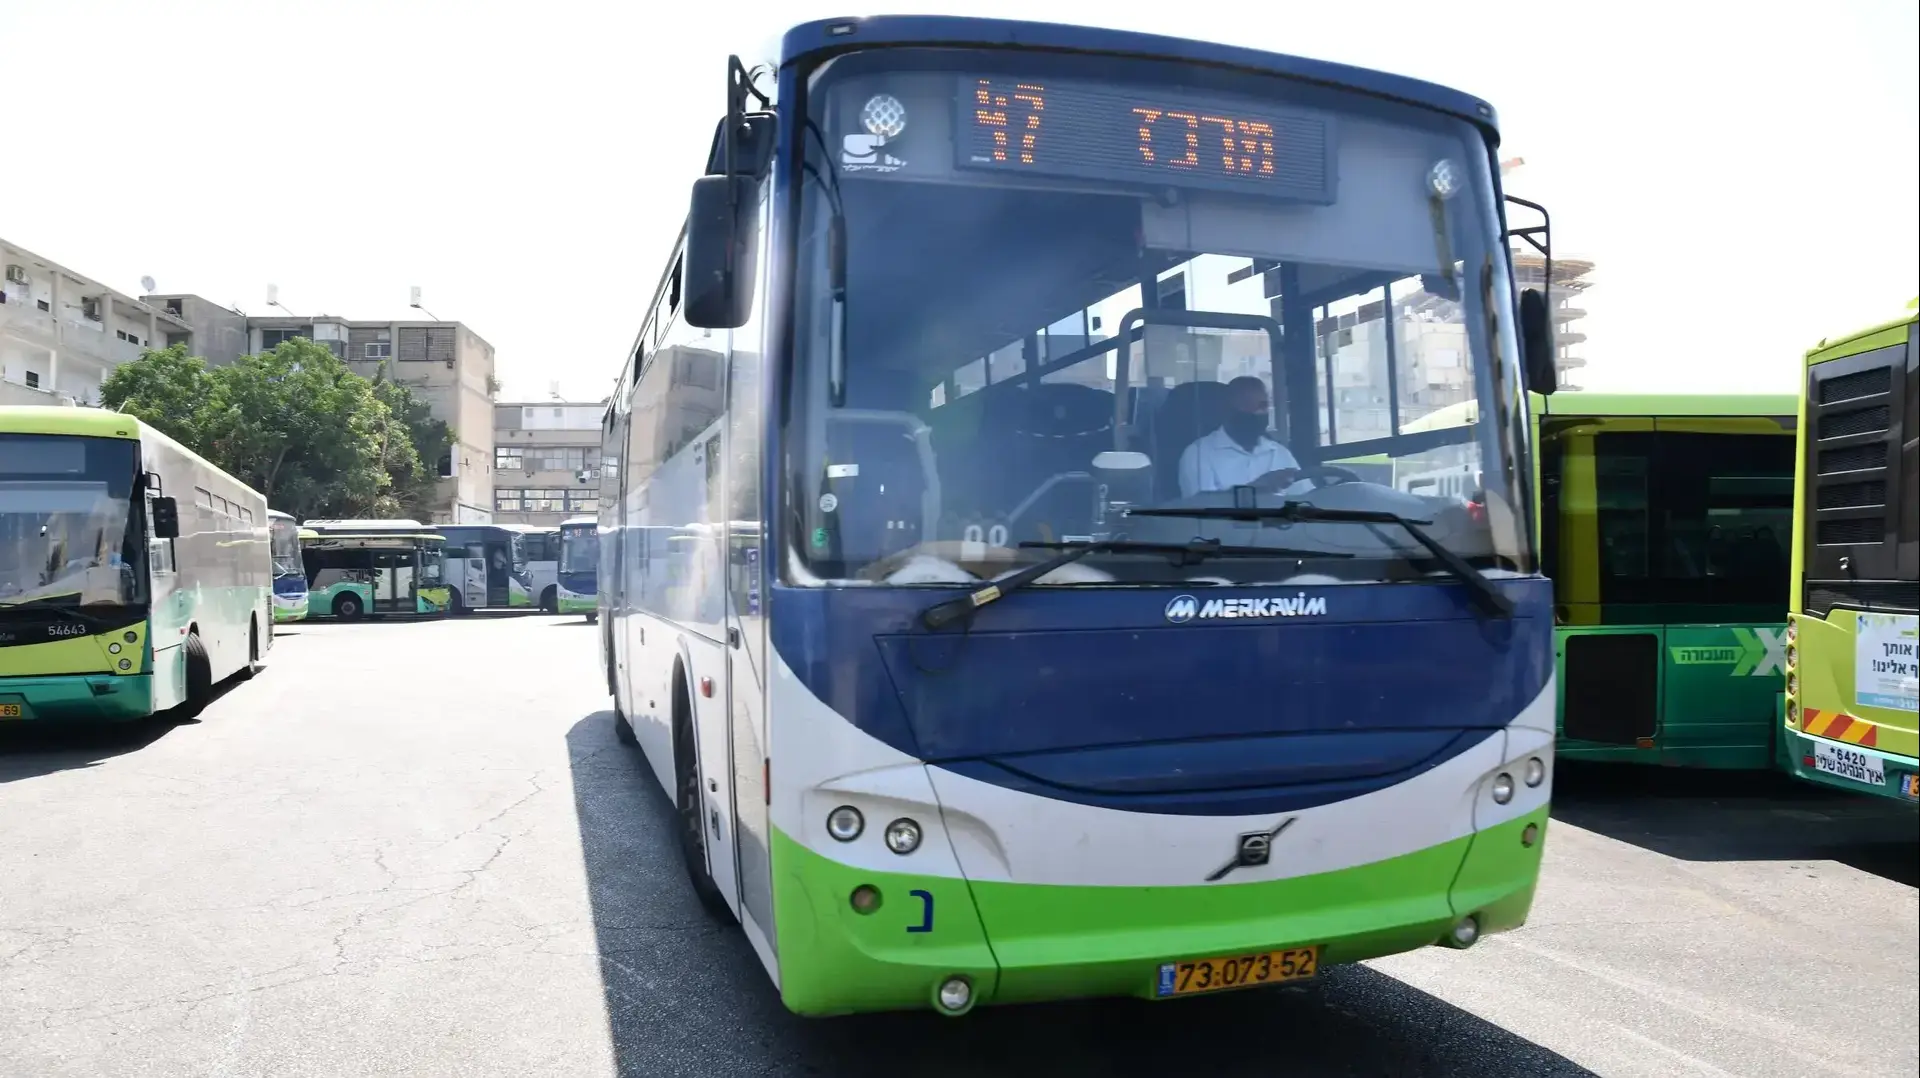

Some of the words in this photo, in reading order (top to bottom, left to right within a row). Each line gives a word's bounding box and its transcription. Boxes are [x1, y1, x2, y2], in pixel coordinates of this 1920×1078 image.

[976, 80, 1044, 163] 47
[1132, 107, 1274, 179] מרכז
[48, 624, 86, 636] 54643
[1883, 642, 1912, 657] אותך
[1872, 659, 1907, 674] אלינו!
[1837, 761, 1865, 780] הנהיגה
[1867, 769, 1884, 783] איך
